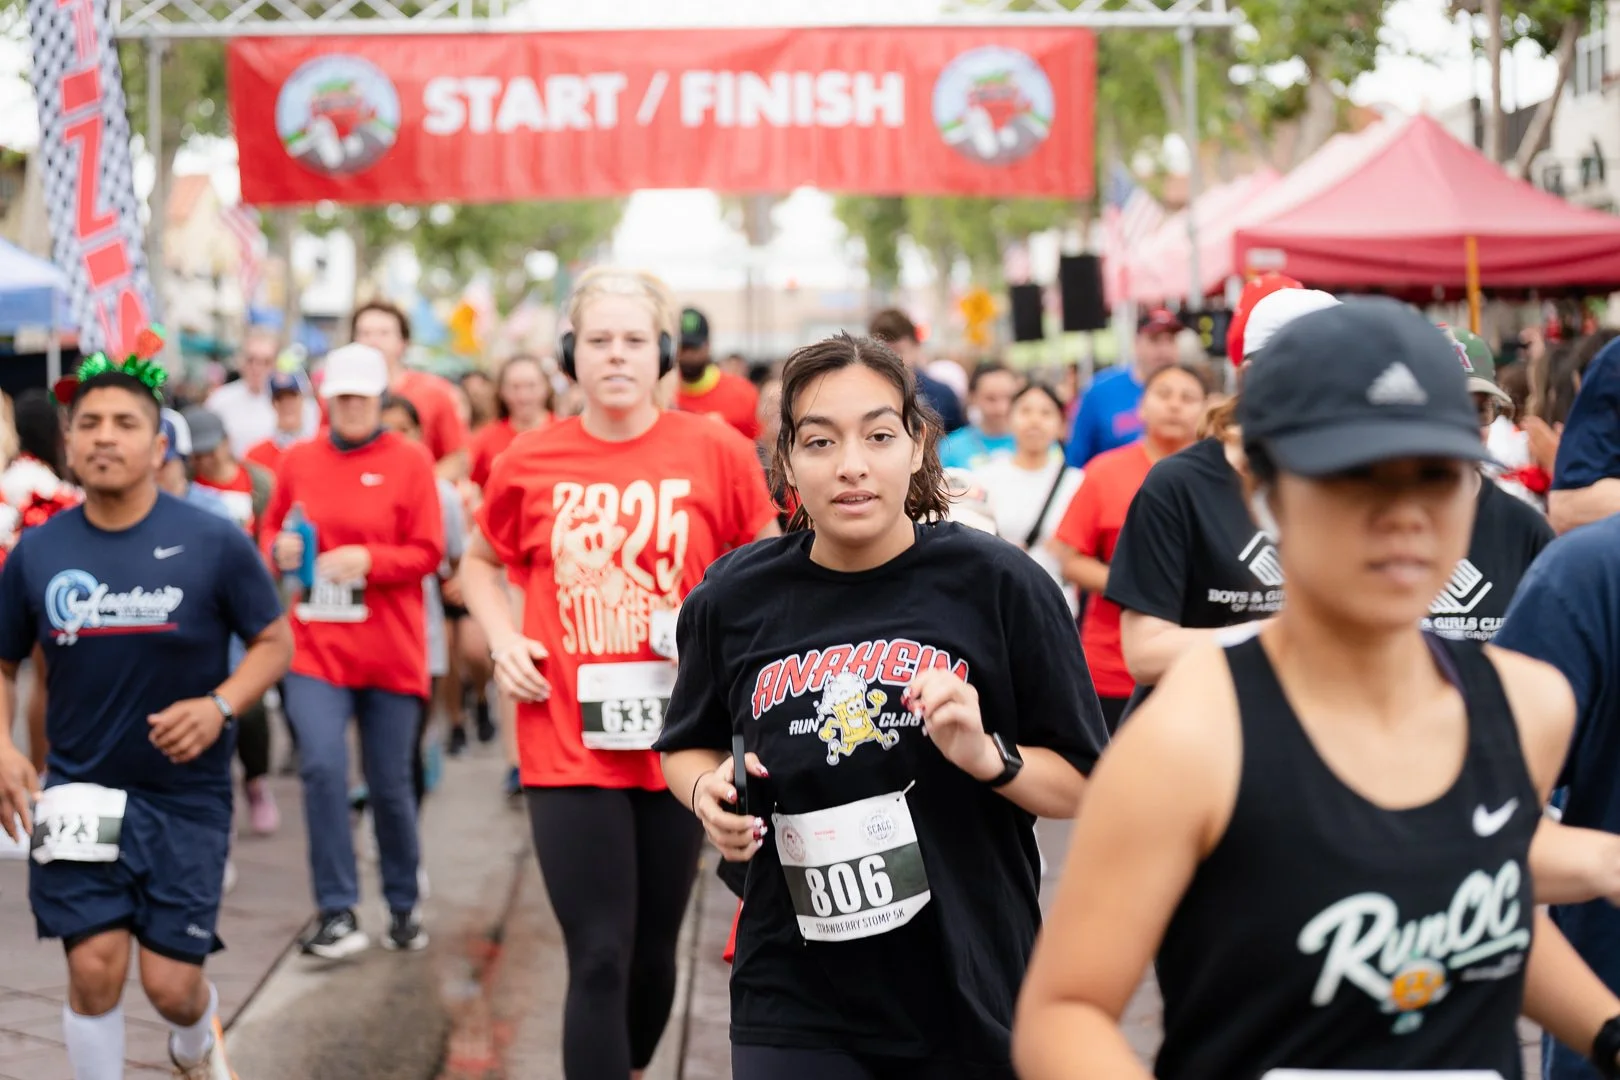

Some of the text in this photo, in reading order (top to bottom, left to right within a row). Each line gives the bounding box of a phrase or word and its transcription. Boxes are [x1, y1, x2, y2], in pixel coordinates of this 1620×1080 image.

[422, 72, 628, 136] START
[678, 69, 905, 129] FINISH
[551, 478, 691, 593] 2025
[1207, 588, 1249, 604] BOYS
[1433, 616, 1478, 631] GIRLS
[1480, 617, 1506, 631] CLU
[600, 698, 664, 733] 633
[788, 718, 820, 736] RUN
[804, 854, 893, 917] 806
[816, 907, 905, 934] STRAWBERRY STOMP 5K
